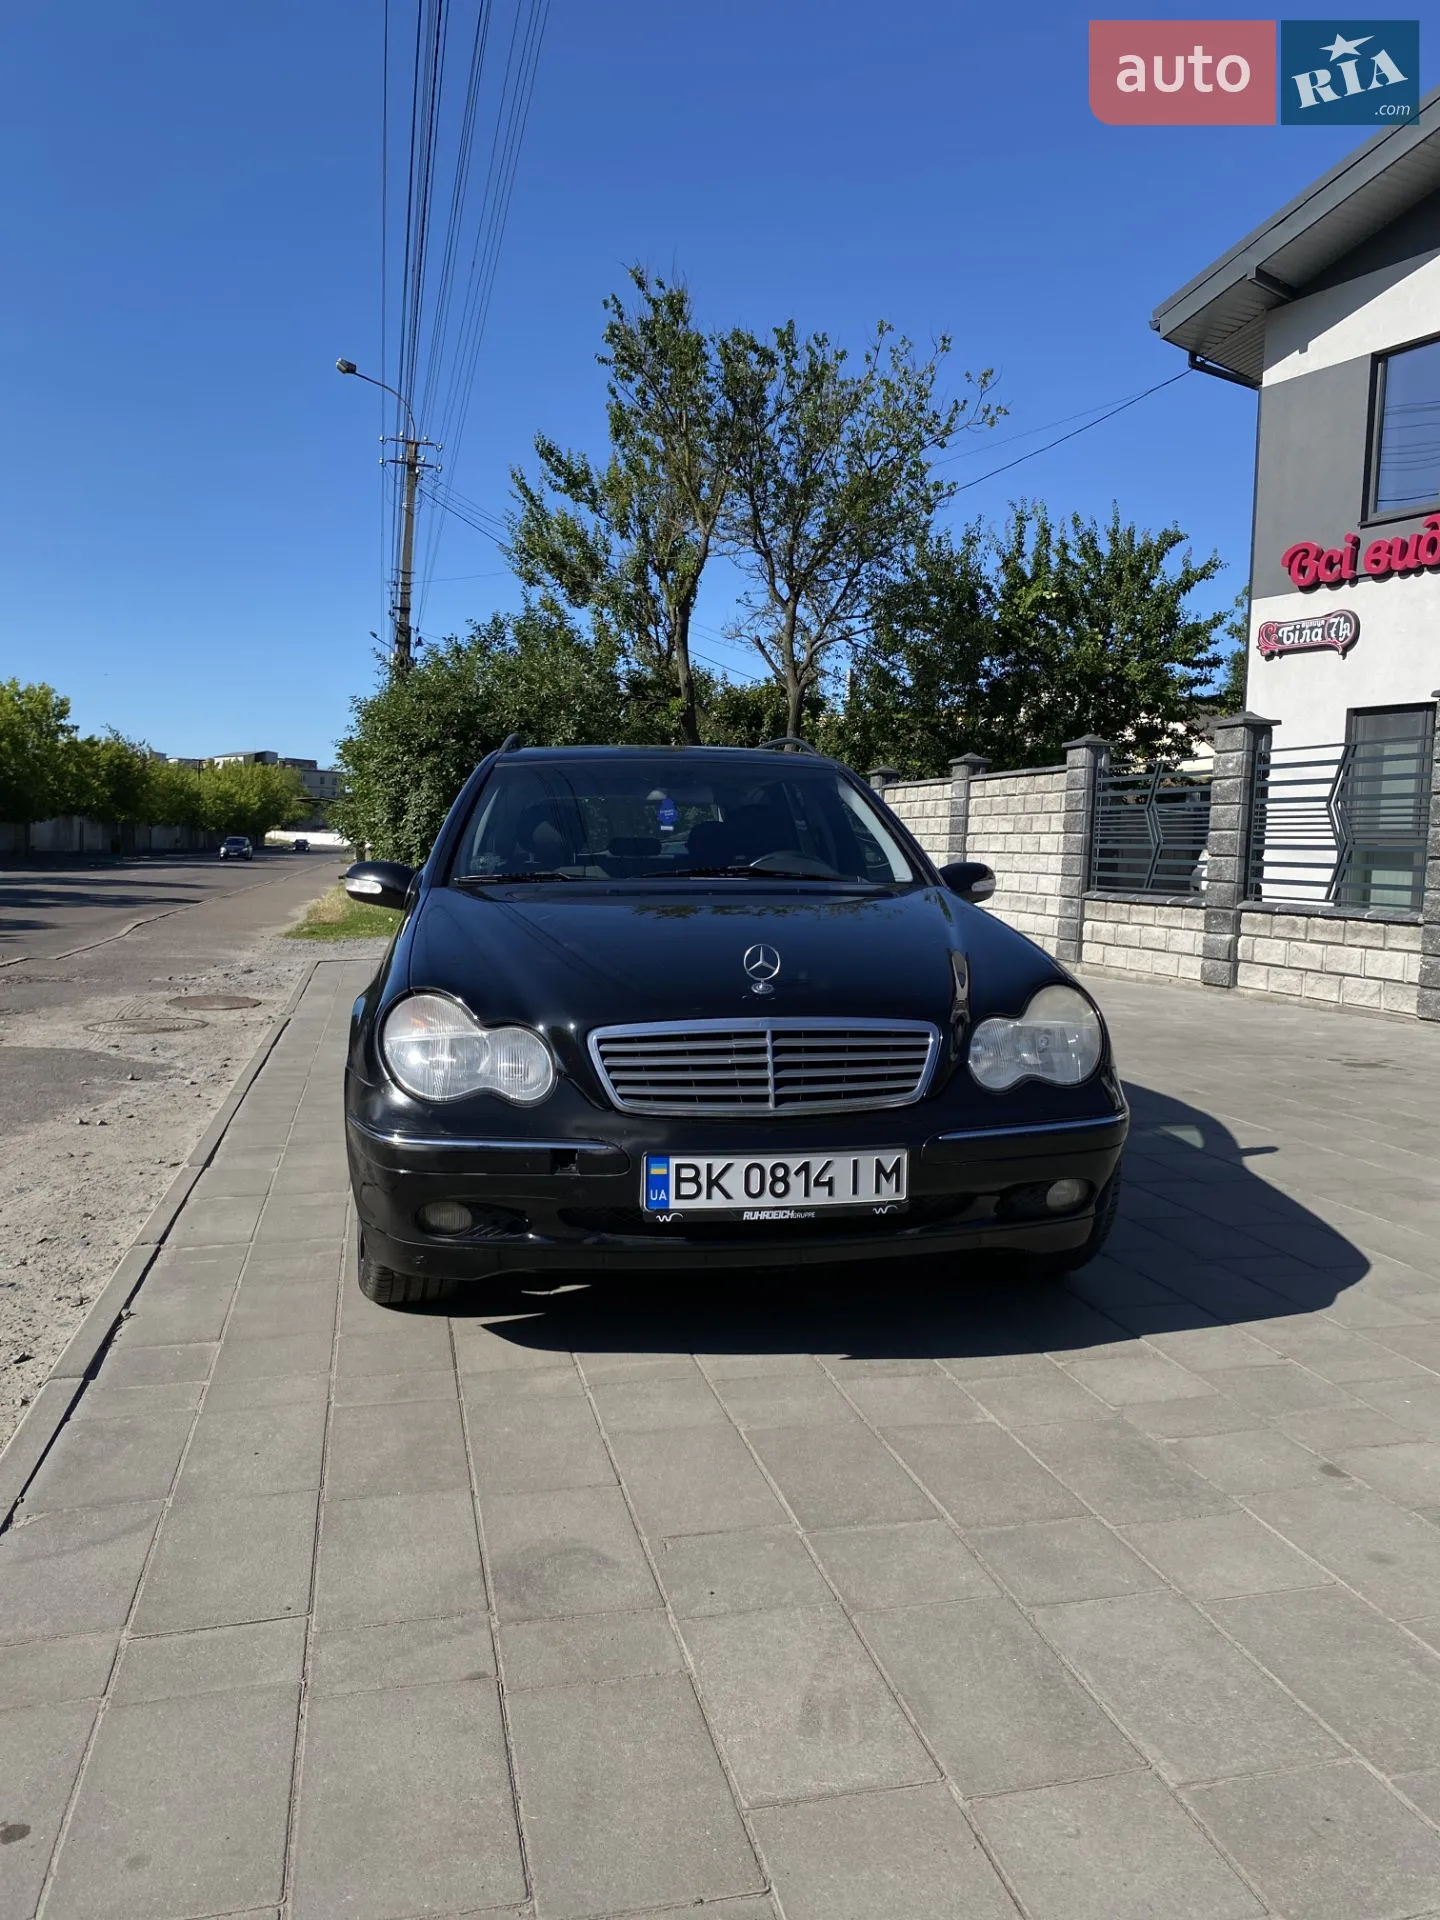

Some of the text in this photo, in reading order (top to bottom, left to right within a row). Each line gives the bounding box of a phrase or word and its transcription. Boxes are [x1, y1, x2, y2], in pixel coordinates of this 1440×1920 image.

[1281, 533, 1358, 587] Всі
[1278, 625, 1323, 645] Біла
[650, 1189, 668, 1201] UA
[674, 1162, 735, 1201] BK
[743, 1160, 834, 1199] 0814
